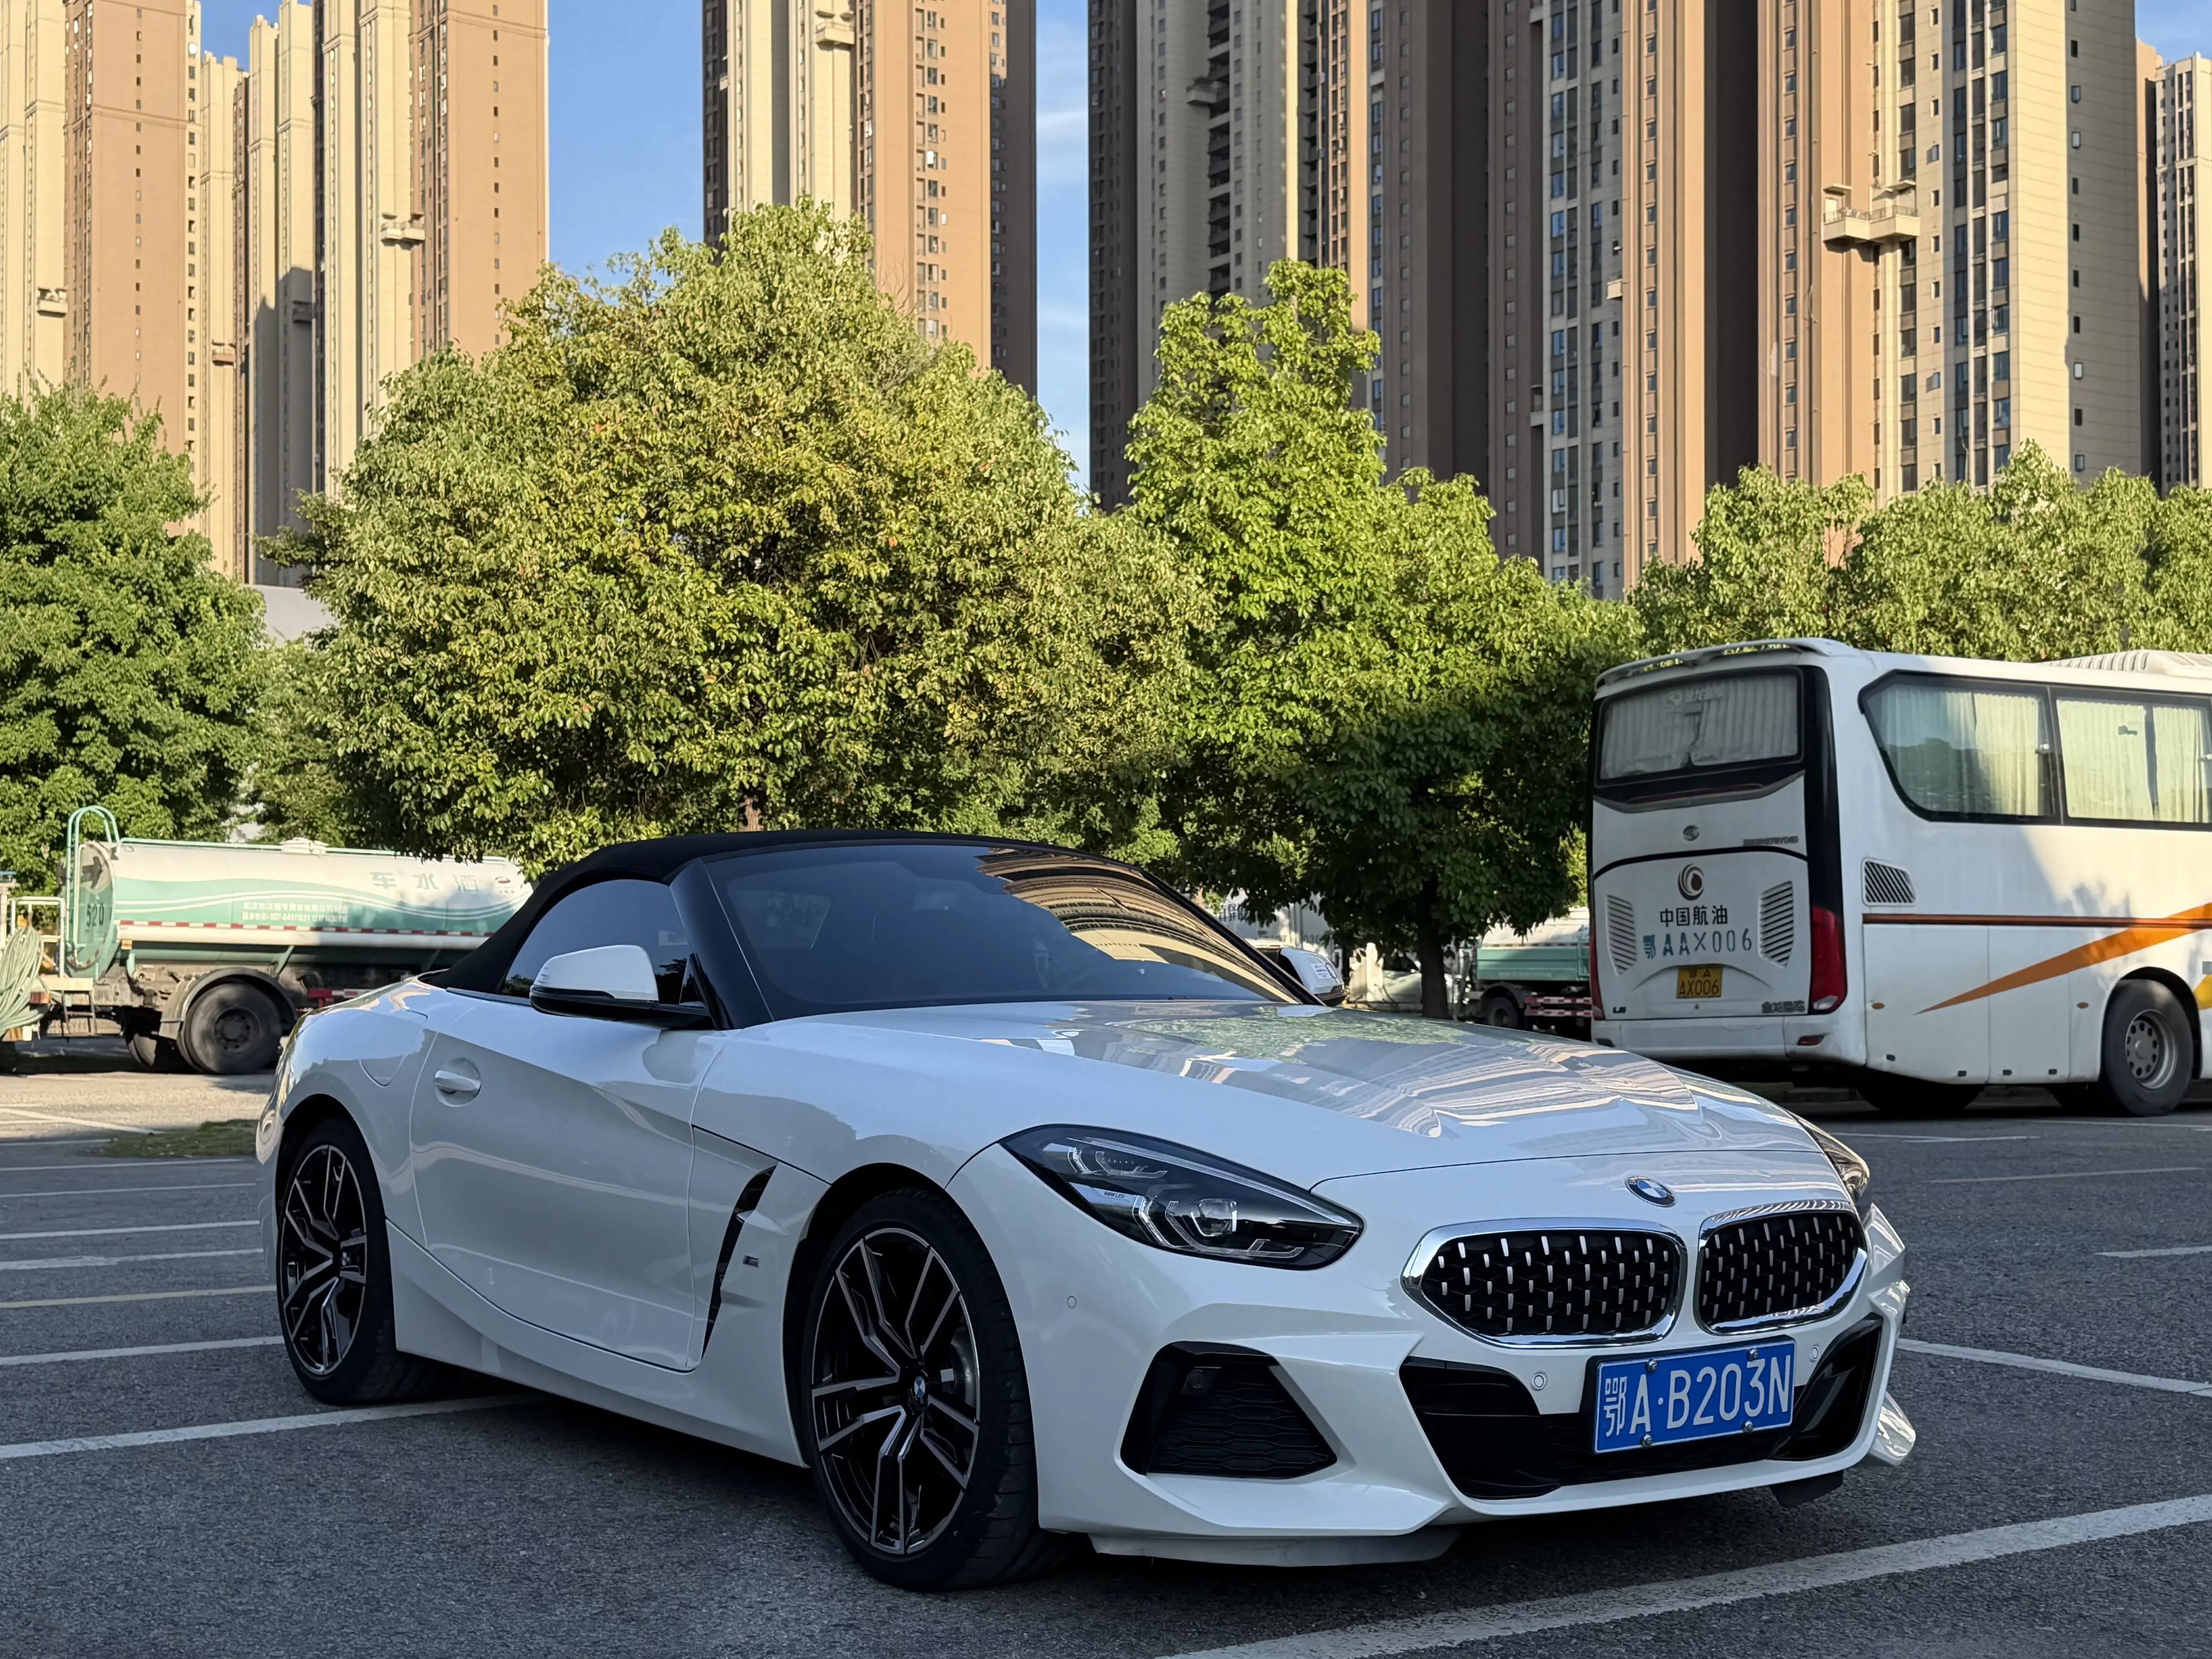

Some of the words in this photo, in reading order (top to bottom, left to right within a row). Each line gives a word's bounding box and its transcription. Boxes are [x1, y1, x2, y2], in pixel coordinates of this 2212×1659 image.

[86, 903, 104, 927] 520
[1660, 905, 1728, 927] 中国航油
[1643, 928, 1752, 959] 鄂AAX006
[1679, 979, 1719, 996] AX006
